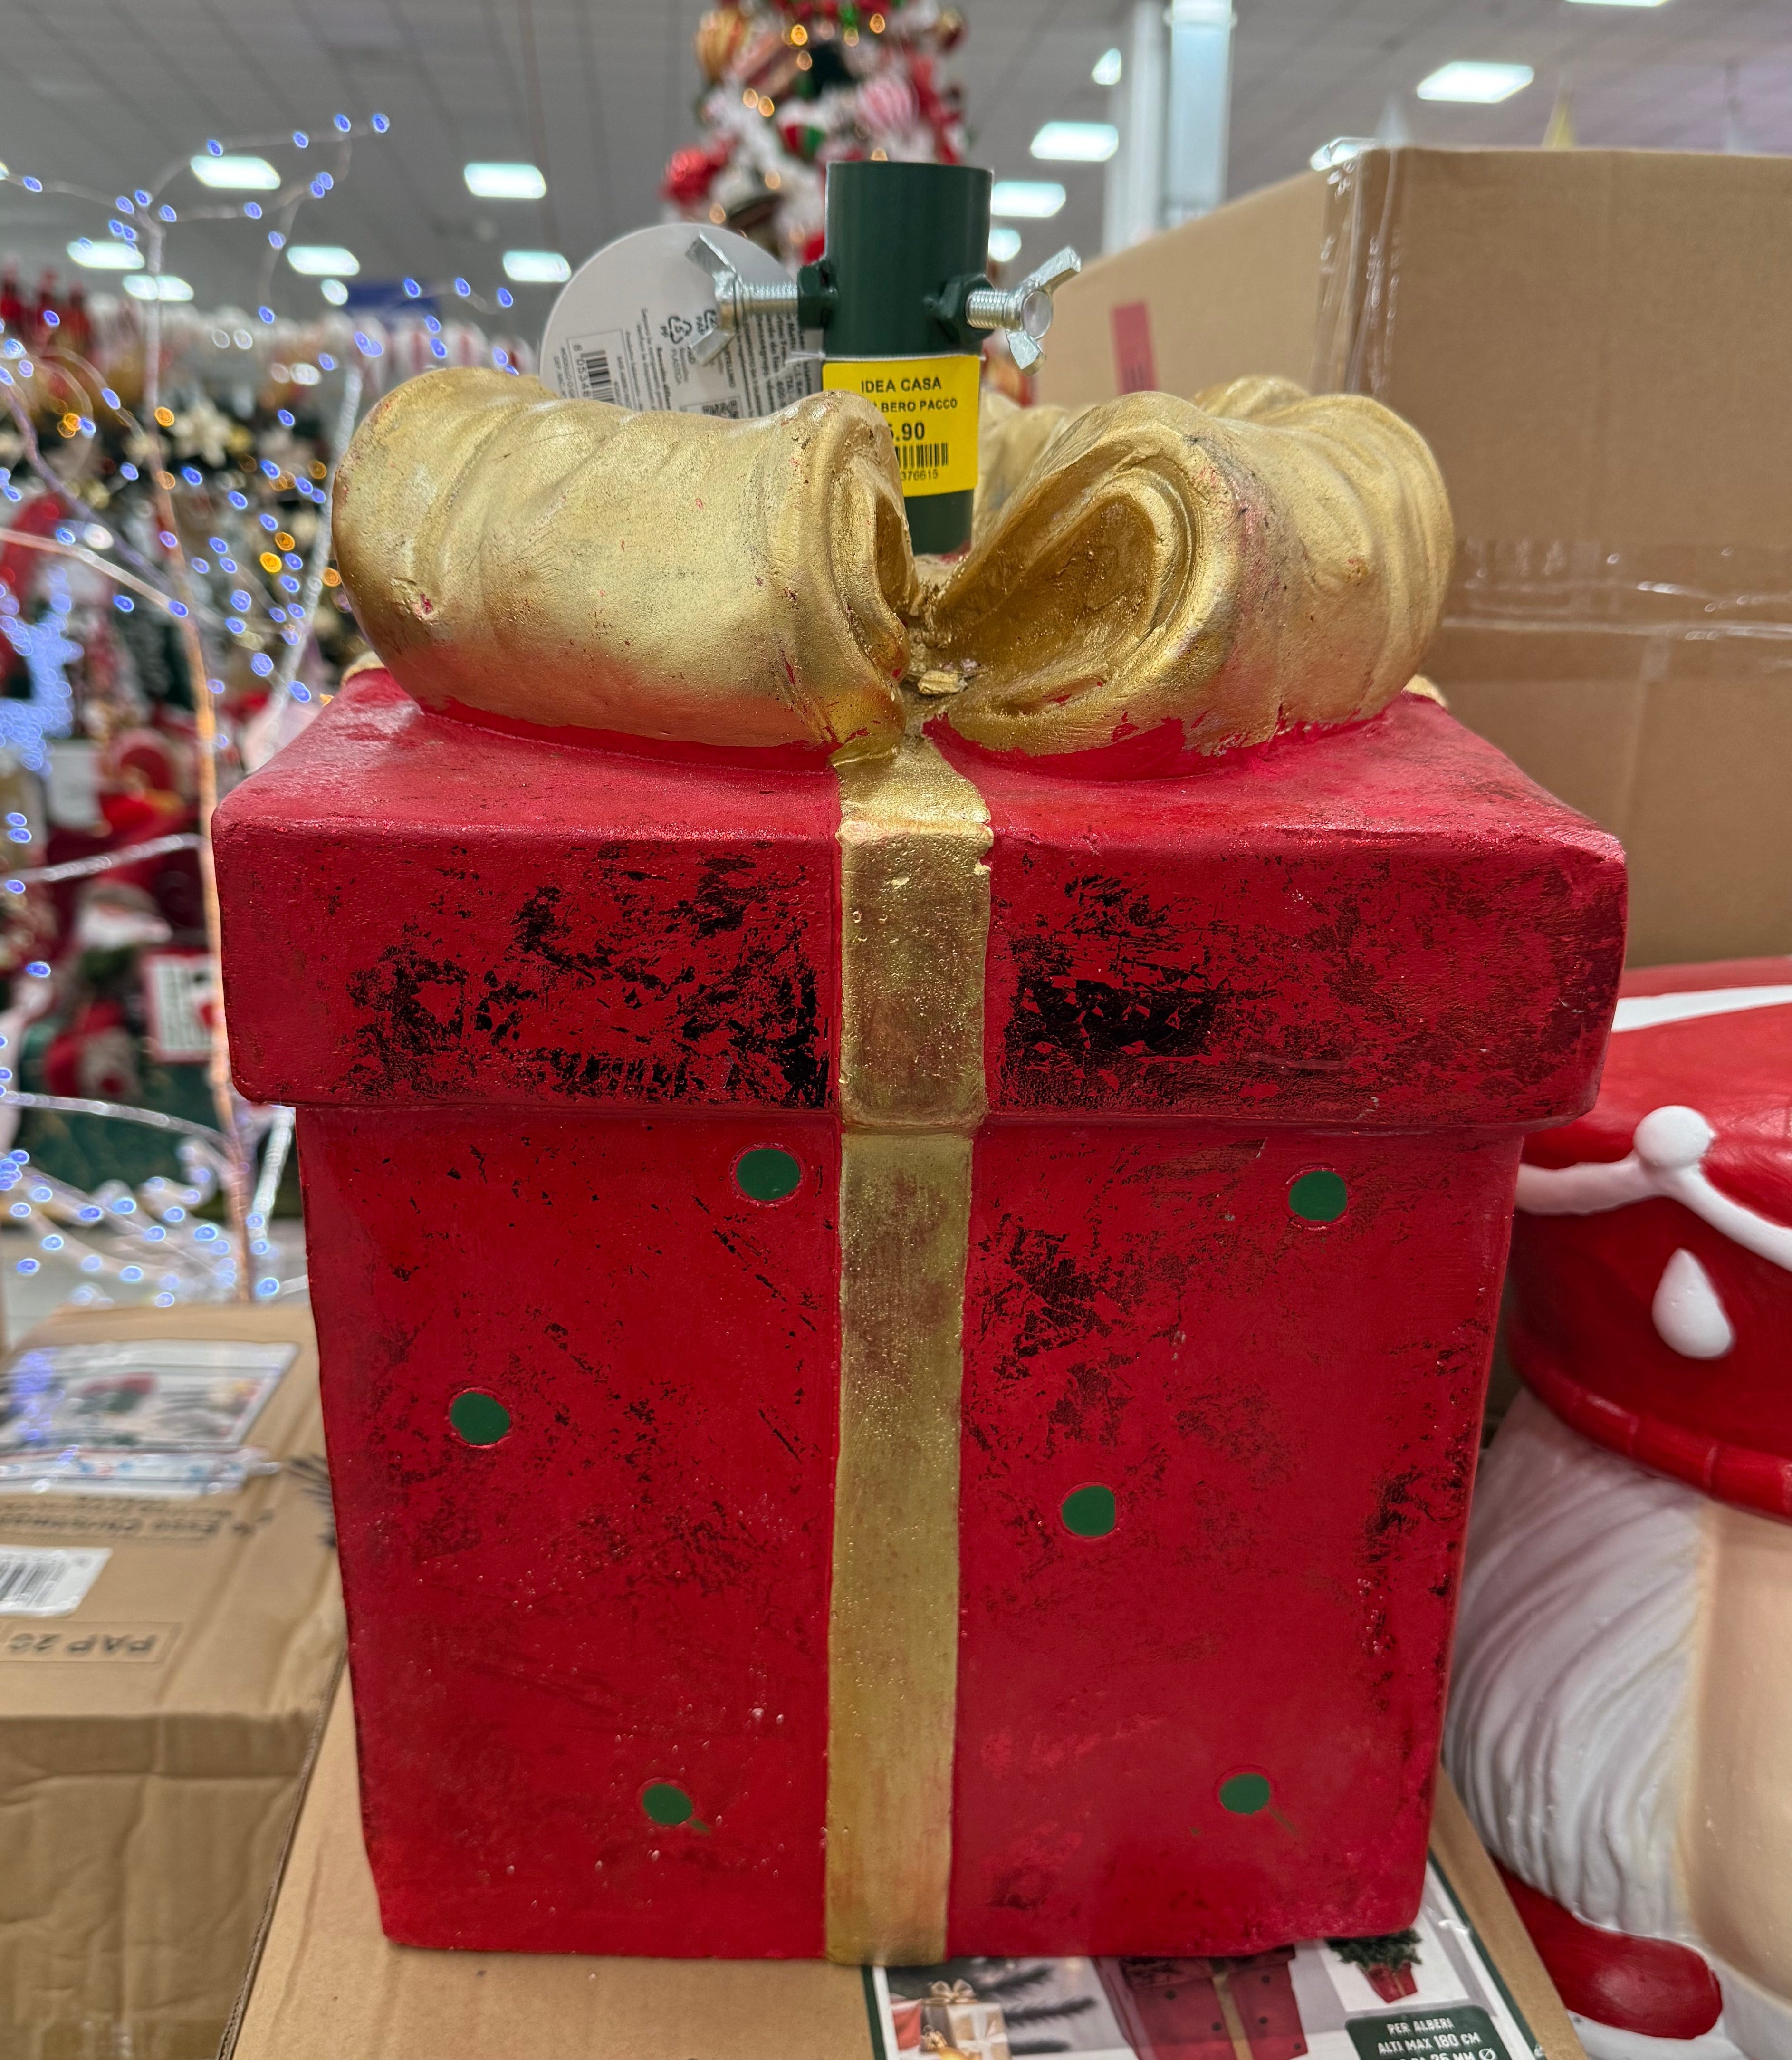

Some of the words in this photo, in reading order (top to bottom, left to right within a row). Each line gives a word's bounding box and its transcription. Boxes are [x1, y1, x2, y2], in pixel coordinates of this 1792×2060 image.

[861, 379, 896, 394] IDEA
[901, 376, 942, 392] CASA
[920, 398, 958, 411] PACCO
[1386, 2022, 1411, 2037] PER
[1413, 2018, 1455, 2034] ALBERI
[1378, 2040, 1405, 2055] ALTI
[1404, 2038, 1435, 2052] MAX
[1433, 2033, 1461, 2050] 180
[1460, 2032, 1483, 2046] CM
